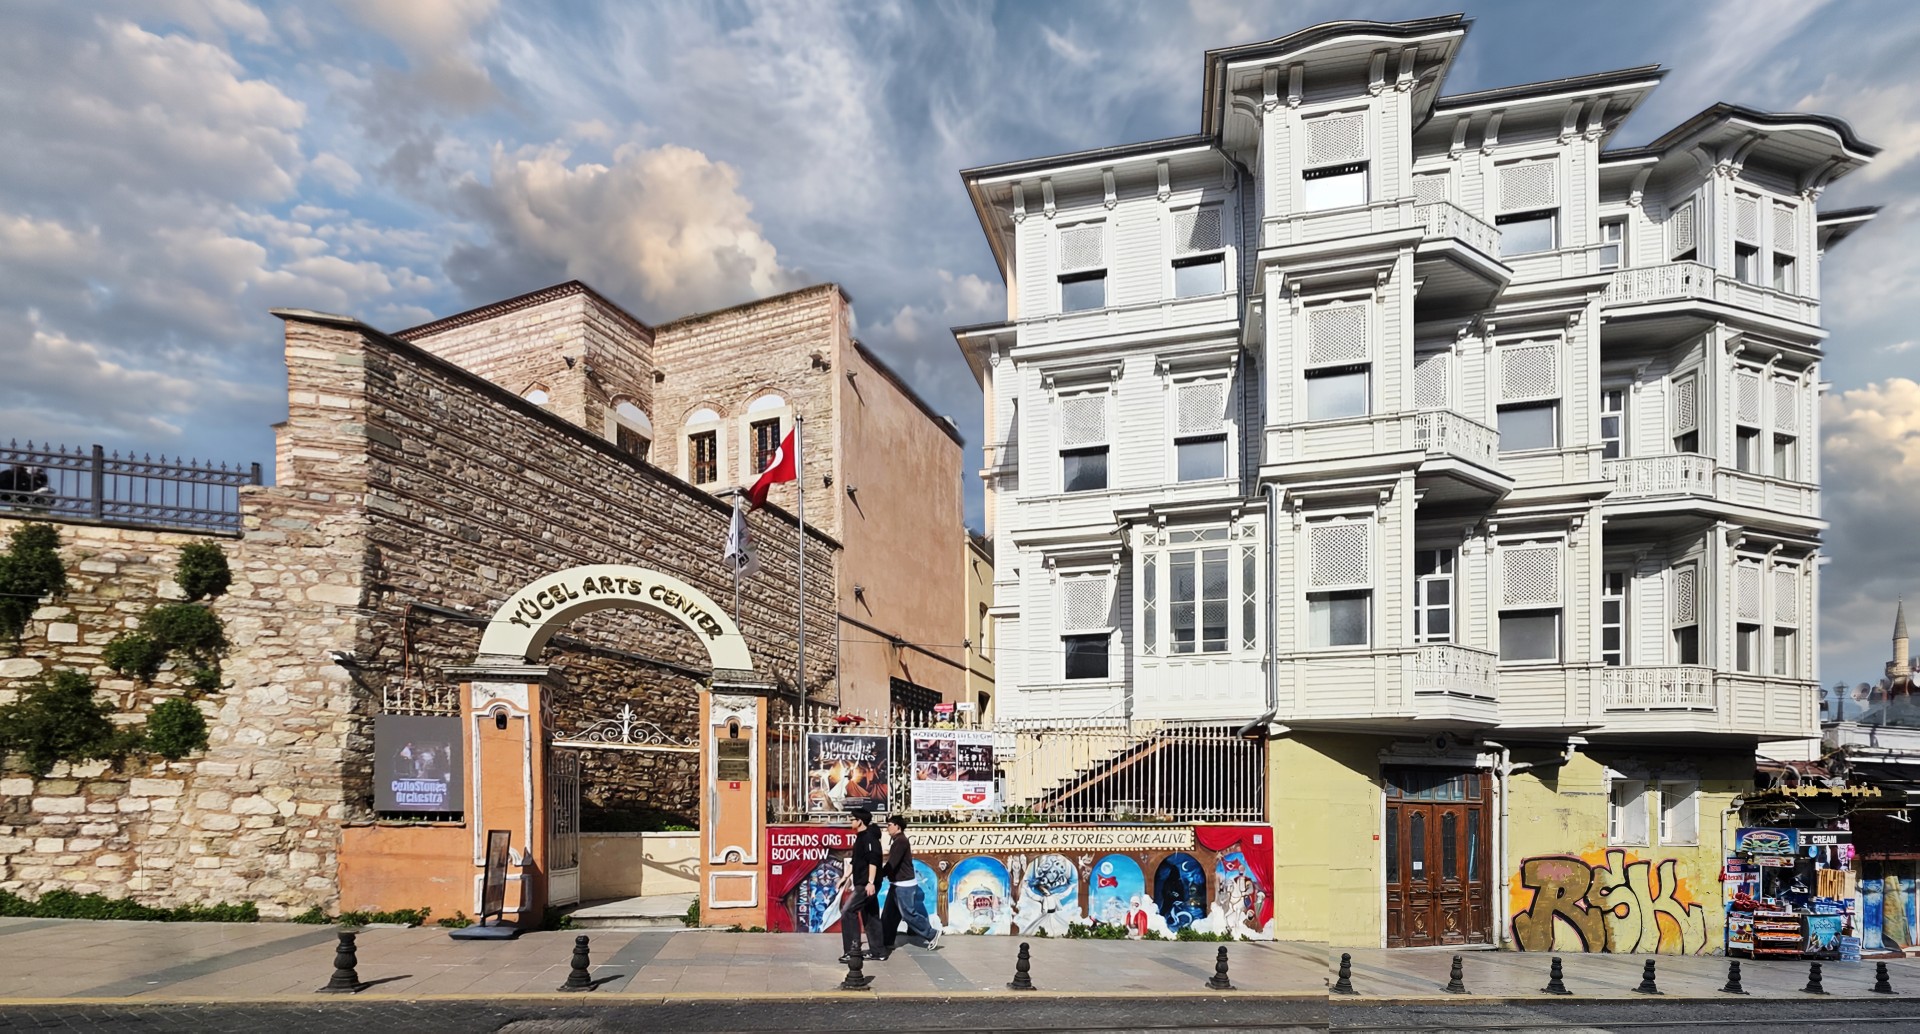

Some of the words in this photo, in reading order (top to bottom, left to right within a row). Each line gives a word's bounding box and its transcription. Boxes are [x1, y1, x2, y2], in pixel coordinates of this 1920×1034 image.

[509, 582, 579, 628] YÜCEL
[582, 575, 642, 596] ARTS
[649, 584, 723, 640] CENTER
[771, 834, 819, 847] LEGENDS
[821, 834, 842, 846] ORG
[889, 834, 956, 846] GENDS
[959, 834, 978, 846] OF
[980, 834, 1047, 845] ISTANBUL
[1061, 833, 1114, 845] STORIES
[1117, 833, 1150, 844] COME
[1151, 833, 1187, 844] ALIVE
[1812, 835, 1837, 844] CREAM
[771, 847, 801, 860] BOOK
[803, 848, 829, 860] NOW
